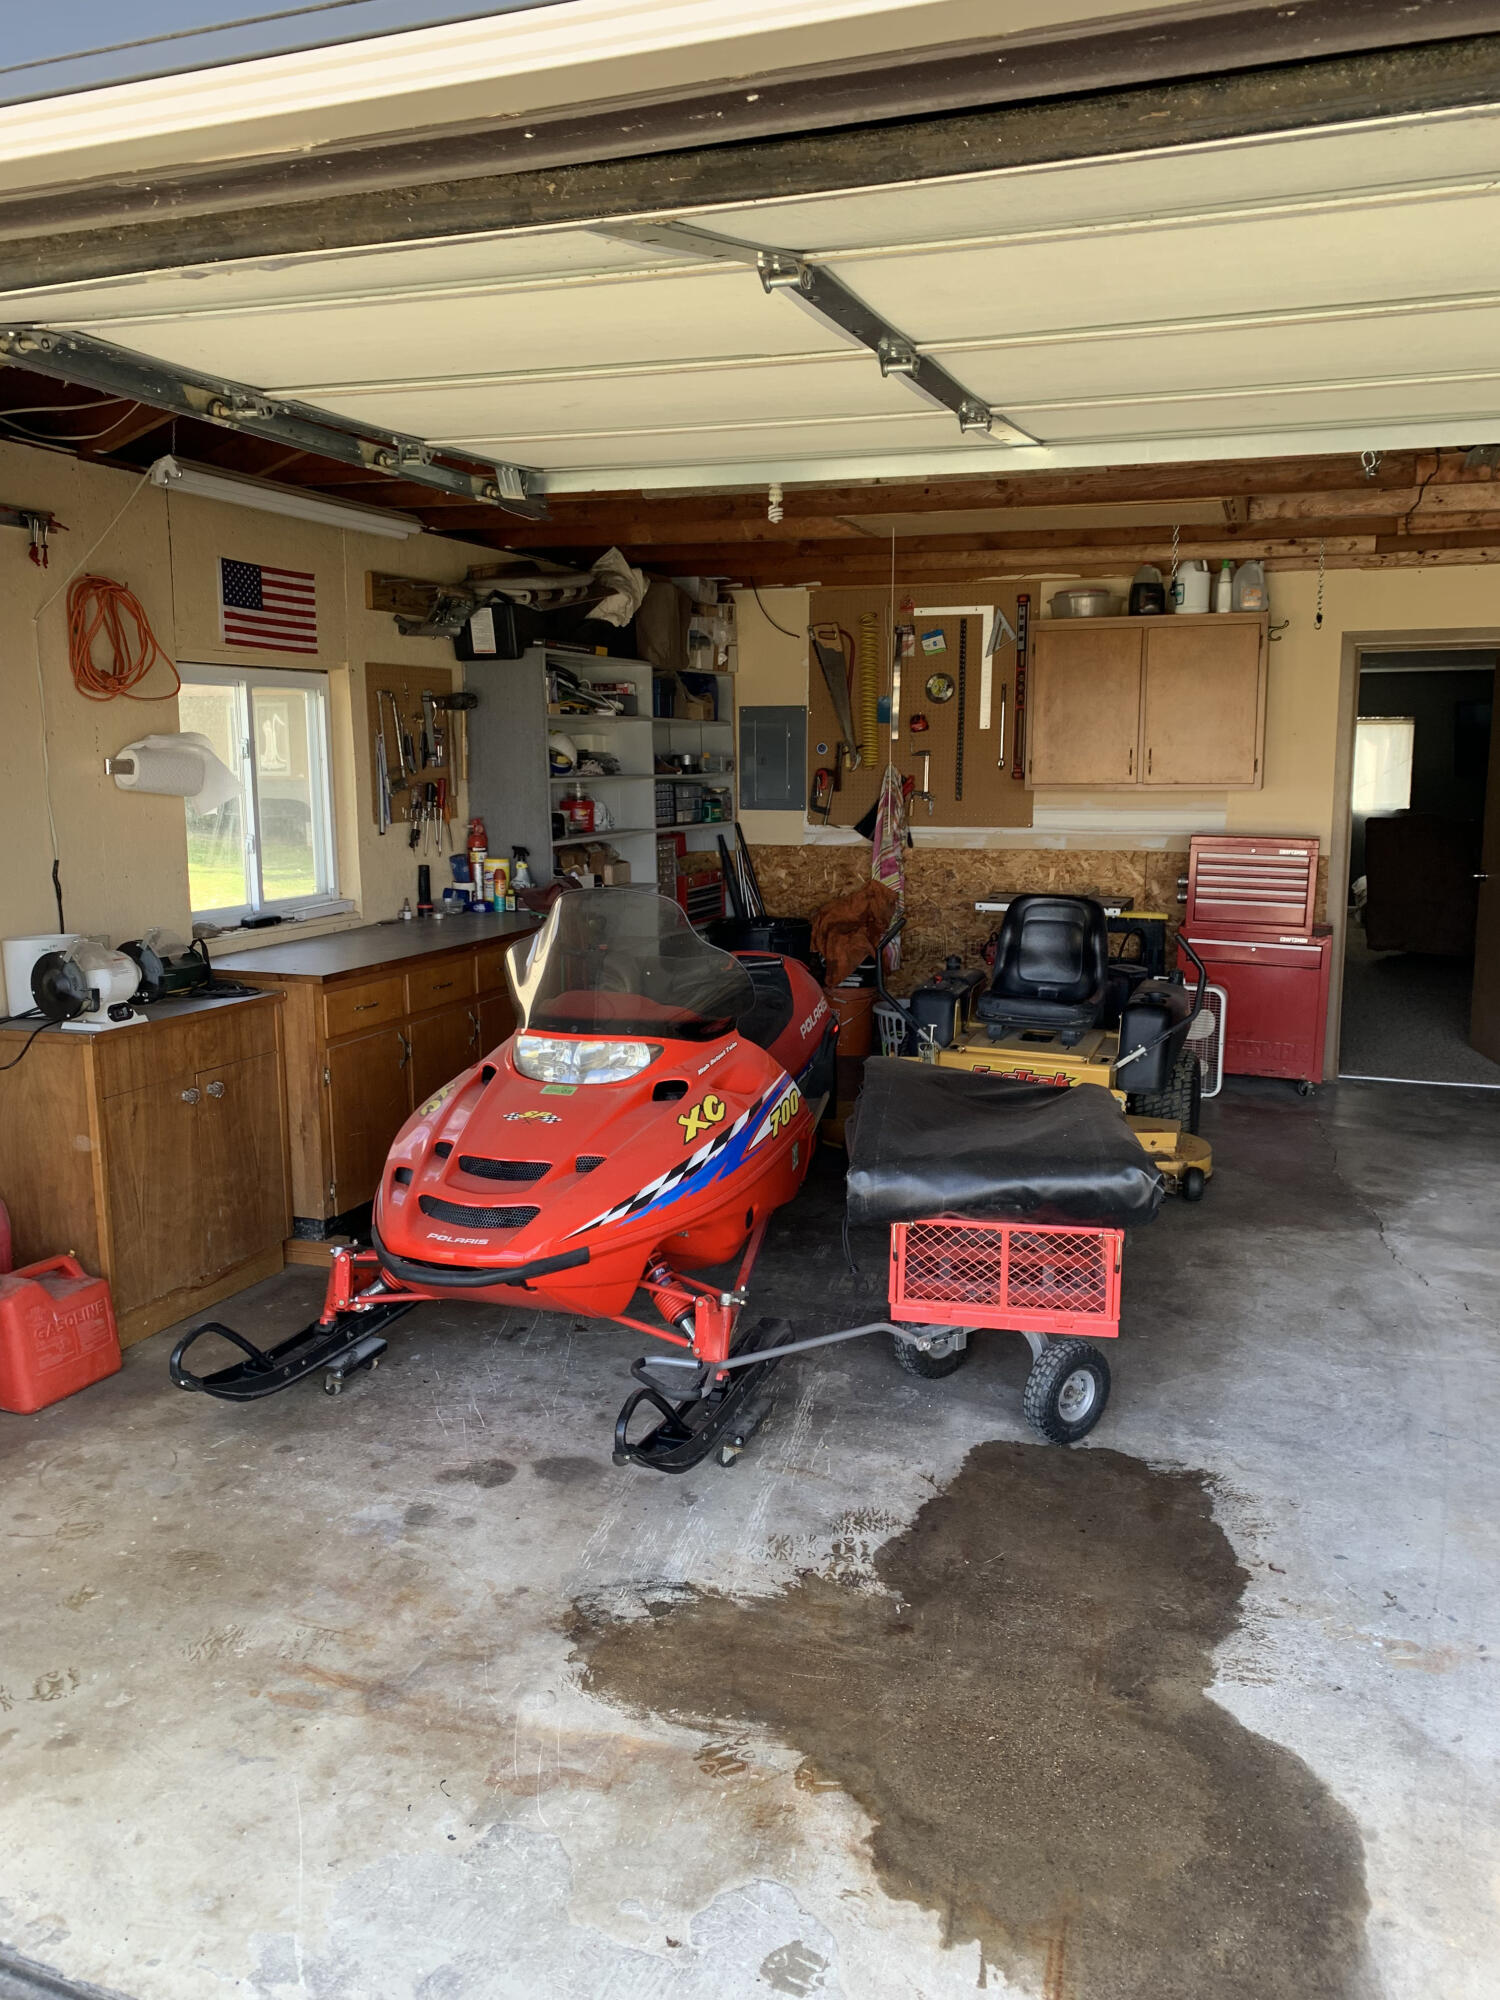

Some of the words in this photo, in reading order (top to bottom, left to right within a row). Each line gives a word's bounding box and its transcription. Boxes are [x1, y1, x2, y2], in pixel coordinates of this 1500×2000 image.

[677, 1094, 726, 1145] XC
[769, 1088, 799, 1140] 700
[426, 1232, 489, 1245] POLARIS
